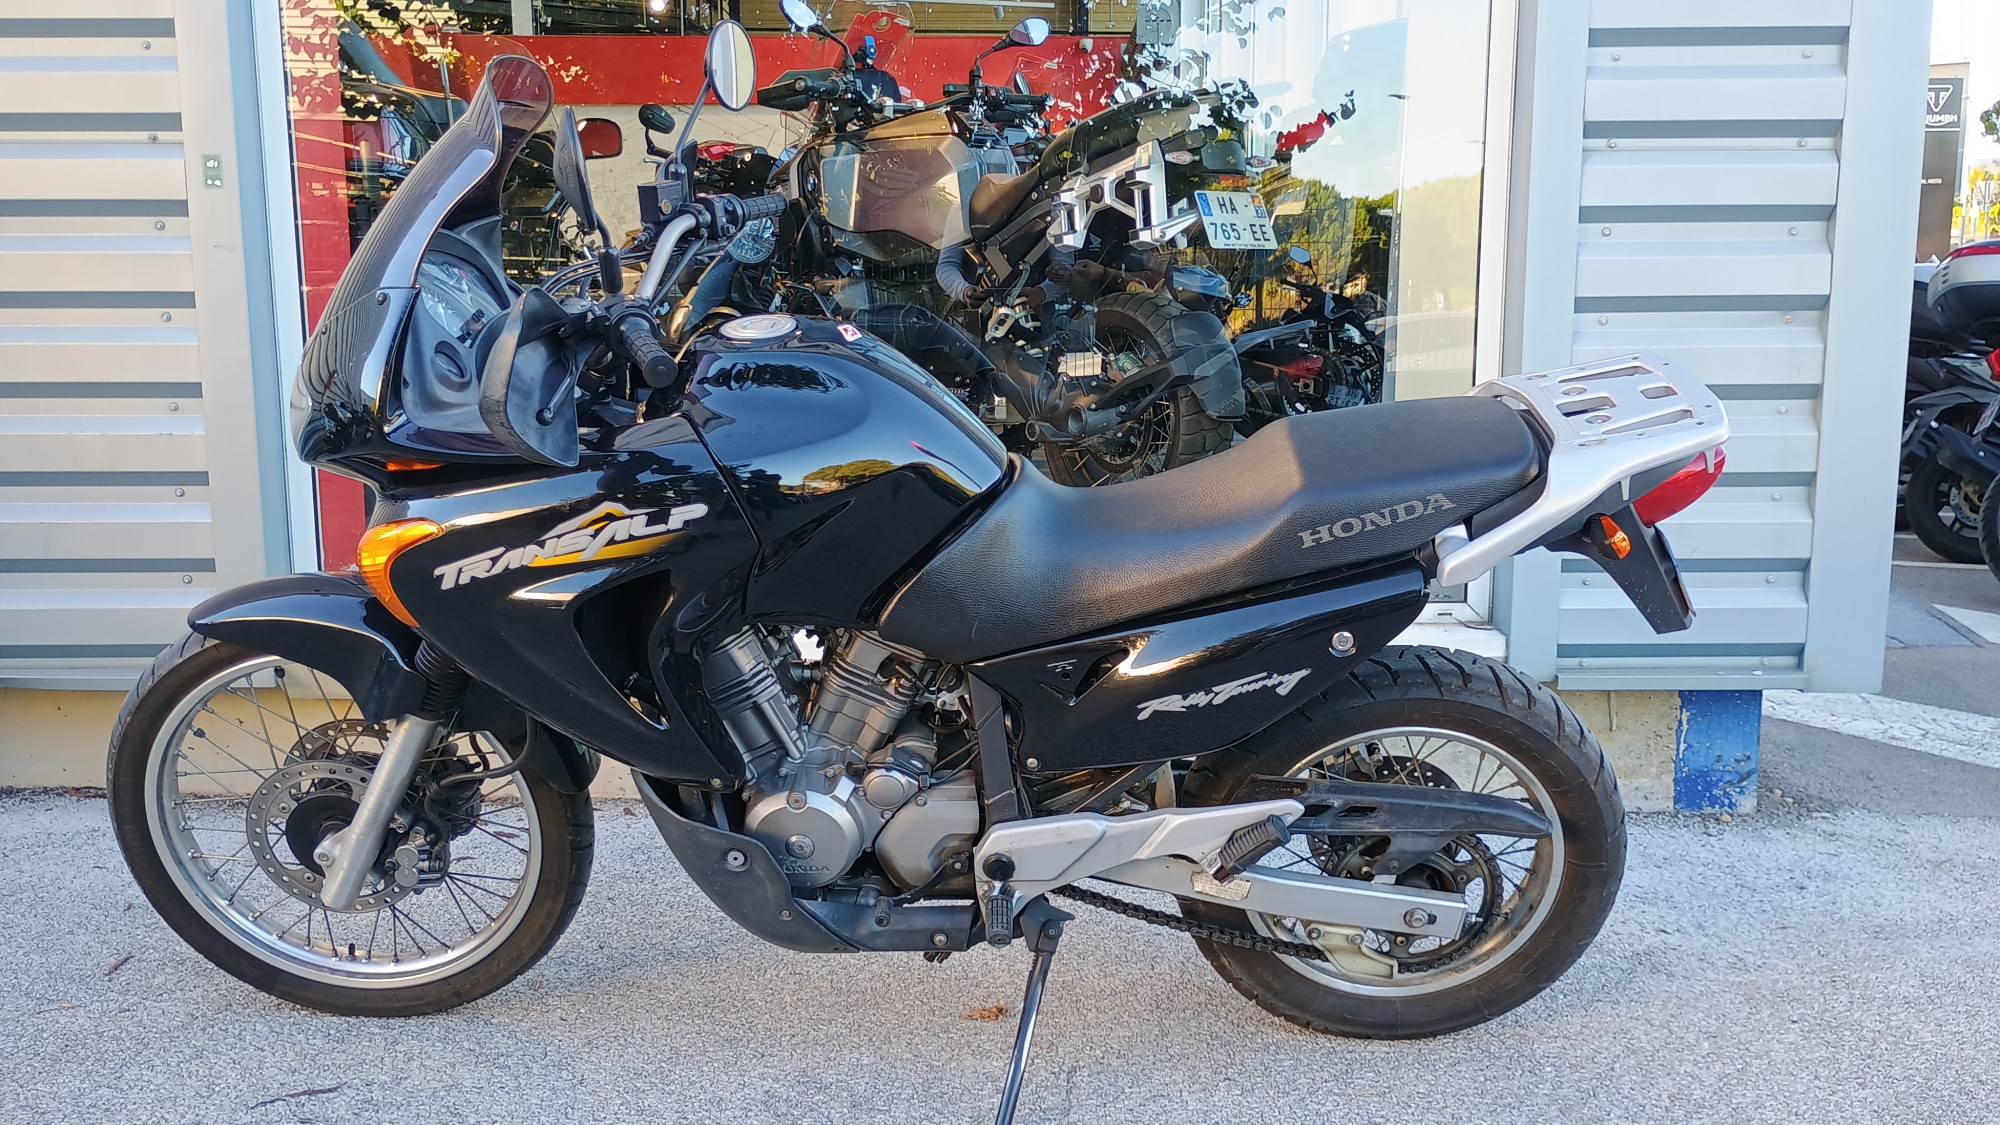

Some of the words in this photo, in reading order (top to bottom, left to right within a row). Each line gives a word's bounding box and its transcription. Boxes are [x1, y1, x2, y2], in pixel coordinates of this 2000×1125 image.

[1925, 114, 1958, 125] IUMPH
[433, 502, 709, 590] TRANSALP
[1298, 493, 1457, 549] HONDA
[1136, 694, 1216, 721] Rally
[1211, 667, 1313, 705] Touring
[783, 865, 832, 874] ONDA
